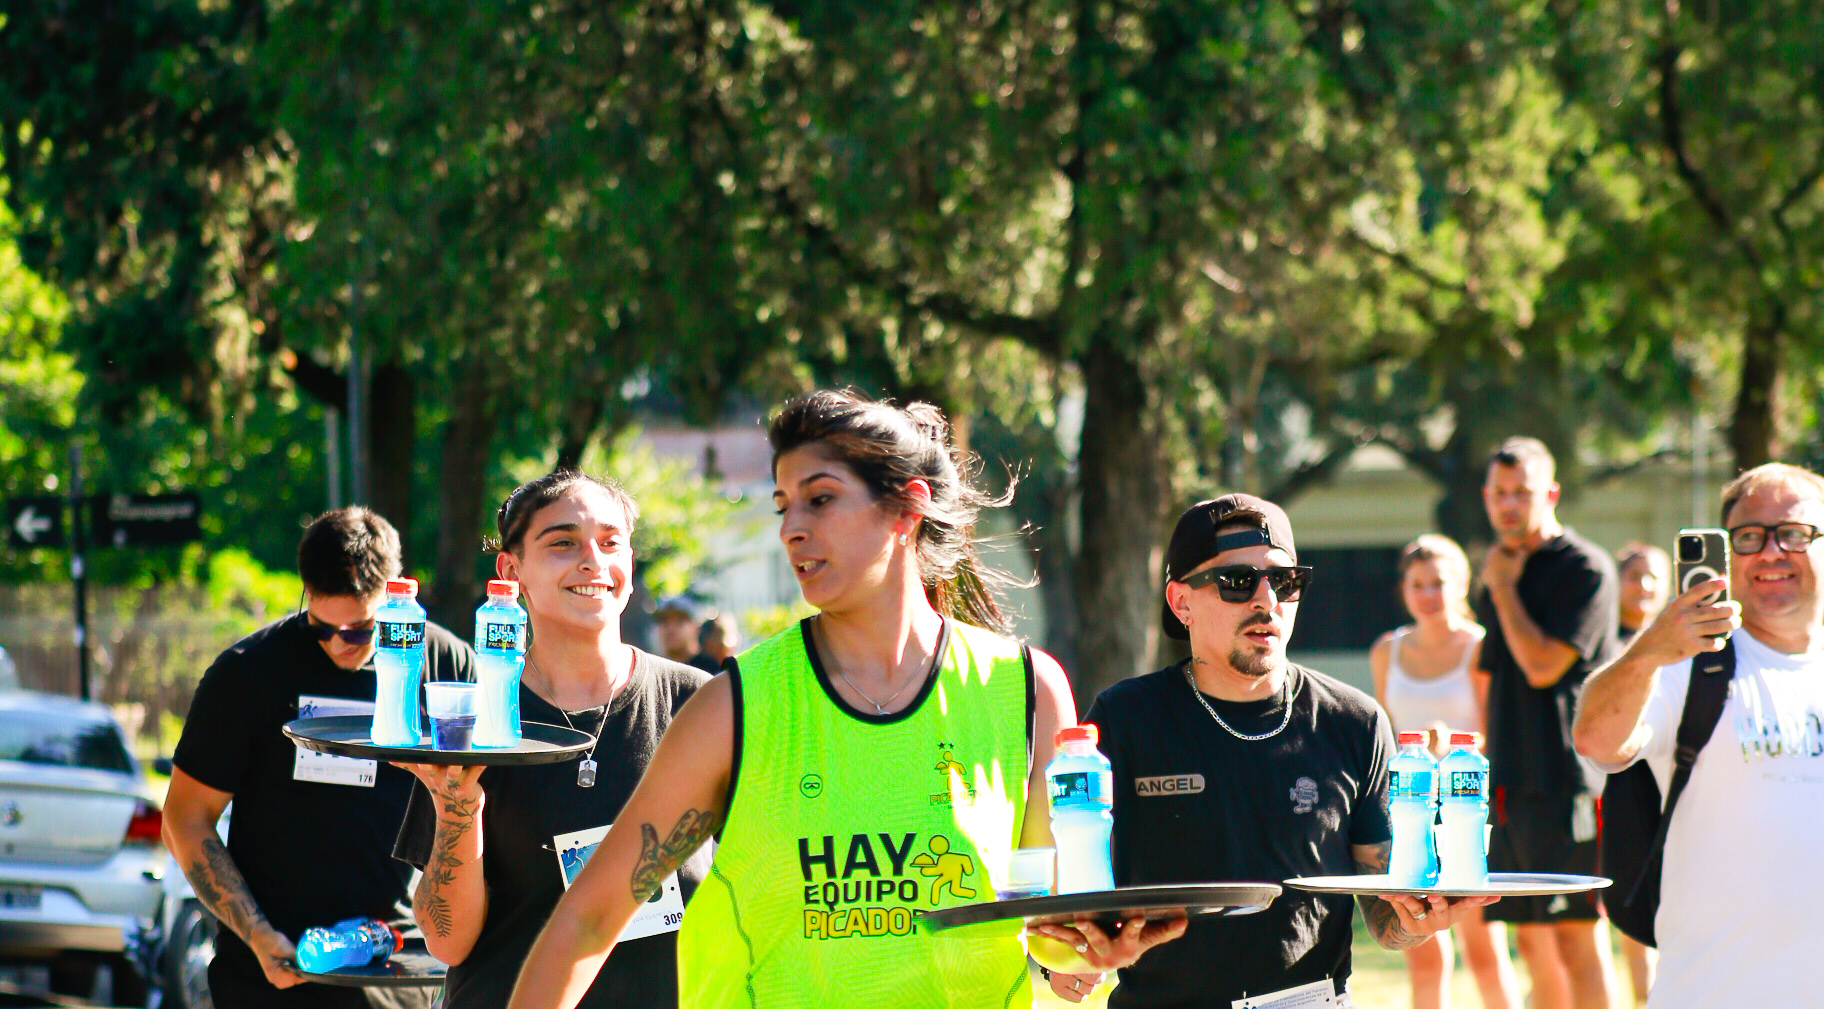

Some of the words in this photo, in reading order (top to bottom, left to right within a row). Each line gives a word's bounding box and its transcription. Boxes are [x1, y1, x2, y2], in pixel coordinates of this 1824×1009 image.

[390, 624, 414, 634] FULL
[488, 624, 513, 634] FULL
[390, 632, 421, 642] SPORT
[488, 633, 519, 642] SPOR
[359, 774, 373, 783] 176
[1453, 773, 1478, 782] FULL
[1137, 778, 1202, 793] ANGEL
[1453, 781, 1480, 790] SPOR
[798, 832, 917, 882] HAY
[804, 880, 919, 911] EQUIPO
[663, 912, 683, 926] 309
[803, 906, 924, 940] PICADO
